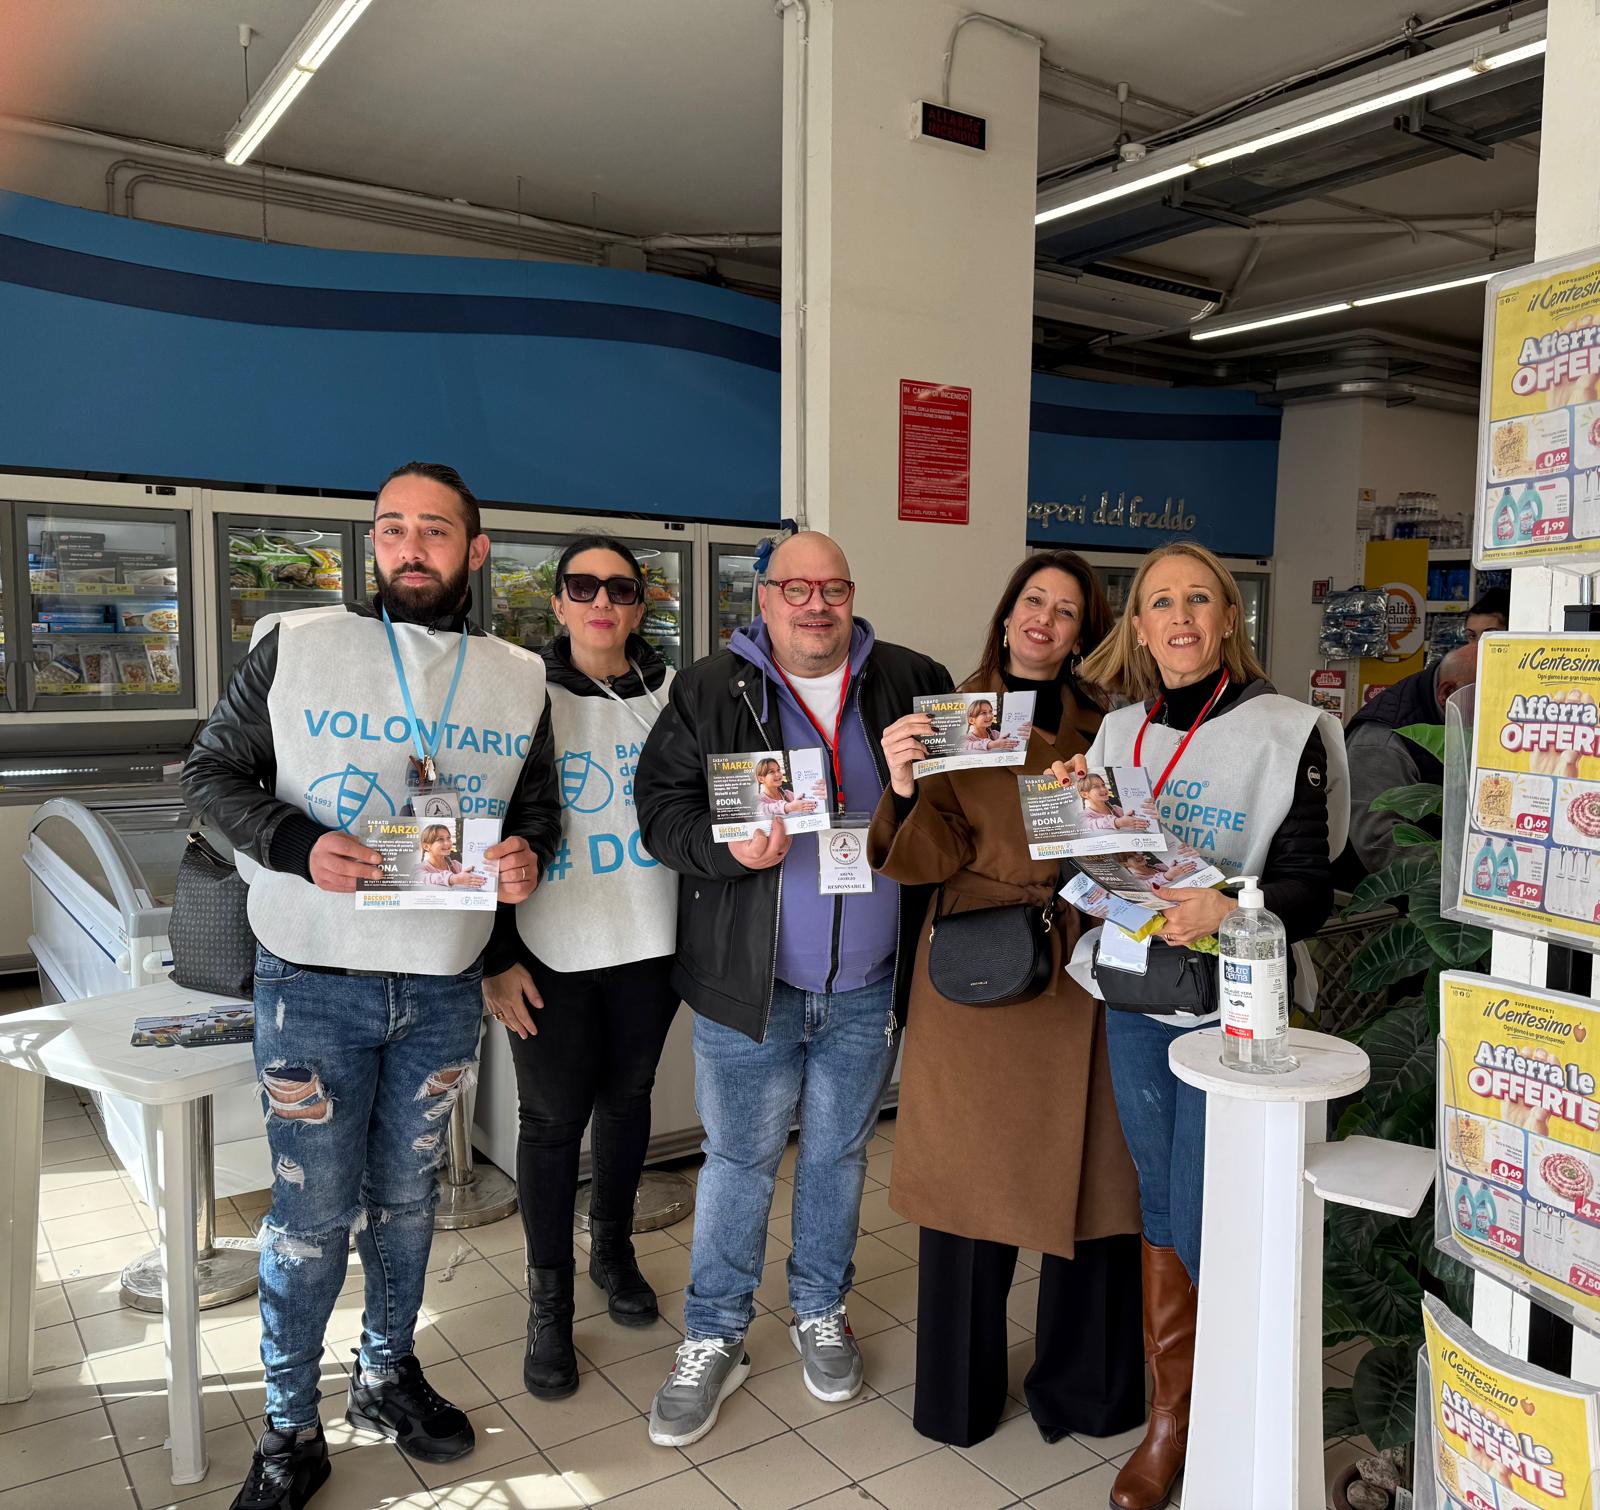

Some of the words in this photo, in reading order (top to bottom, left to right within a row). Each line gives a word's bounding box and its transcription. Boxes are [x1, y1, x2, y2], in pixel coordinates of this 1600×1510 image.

[940, 391, 968, 401] INCENDIO
[1093, 490, 1126, 528] del
[1129, 495, 1197, 532] freddo
[1518, 653, 1530, 669] il
[1529, 647, 1600, 672] Centesim
[931, 702, 966, 711] MARZO
[1507, 695, 1597, 726] Afferra
[721, 761, 754, 771] MARZO
[1037, 781, 1061, 792] MAR
[314, 796, 332, 807] 1993
[716, 798, 742, 806] #DONA
[380, 825, 419, 834] MARZO
[1032, 816, 1064, 826] #DONA
[1175, 802, 1247, 832] OPERE
[1483, 1001, 1495, 1018] il
[1495, 998, 1572, 1037] Centesimo
[1514, 1001, 1555, 1015] SUPERMERCATI
[1474, 1041, 1565, 1088] Afferra
[1565, 1063, 1595, 1095] le
[1468, 1066, 1600, 1132] OFFERTE
[1441, 1347, 1447, 1361] il
[1447, 1350, 1519, 1407] Centesimo
[1440, 1381, 1520, 1452] Afferra
[1519, 1432, 1553, 1465] le
[1440, 1402, 1566, 1498] OFFERTE
